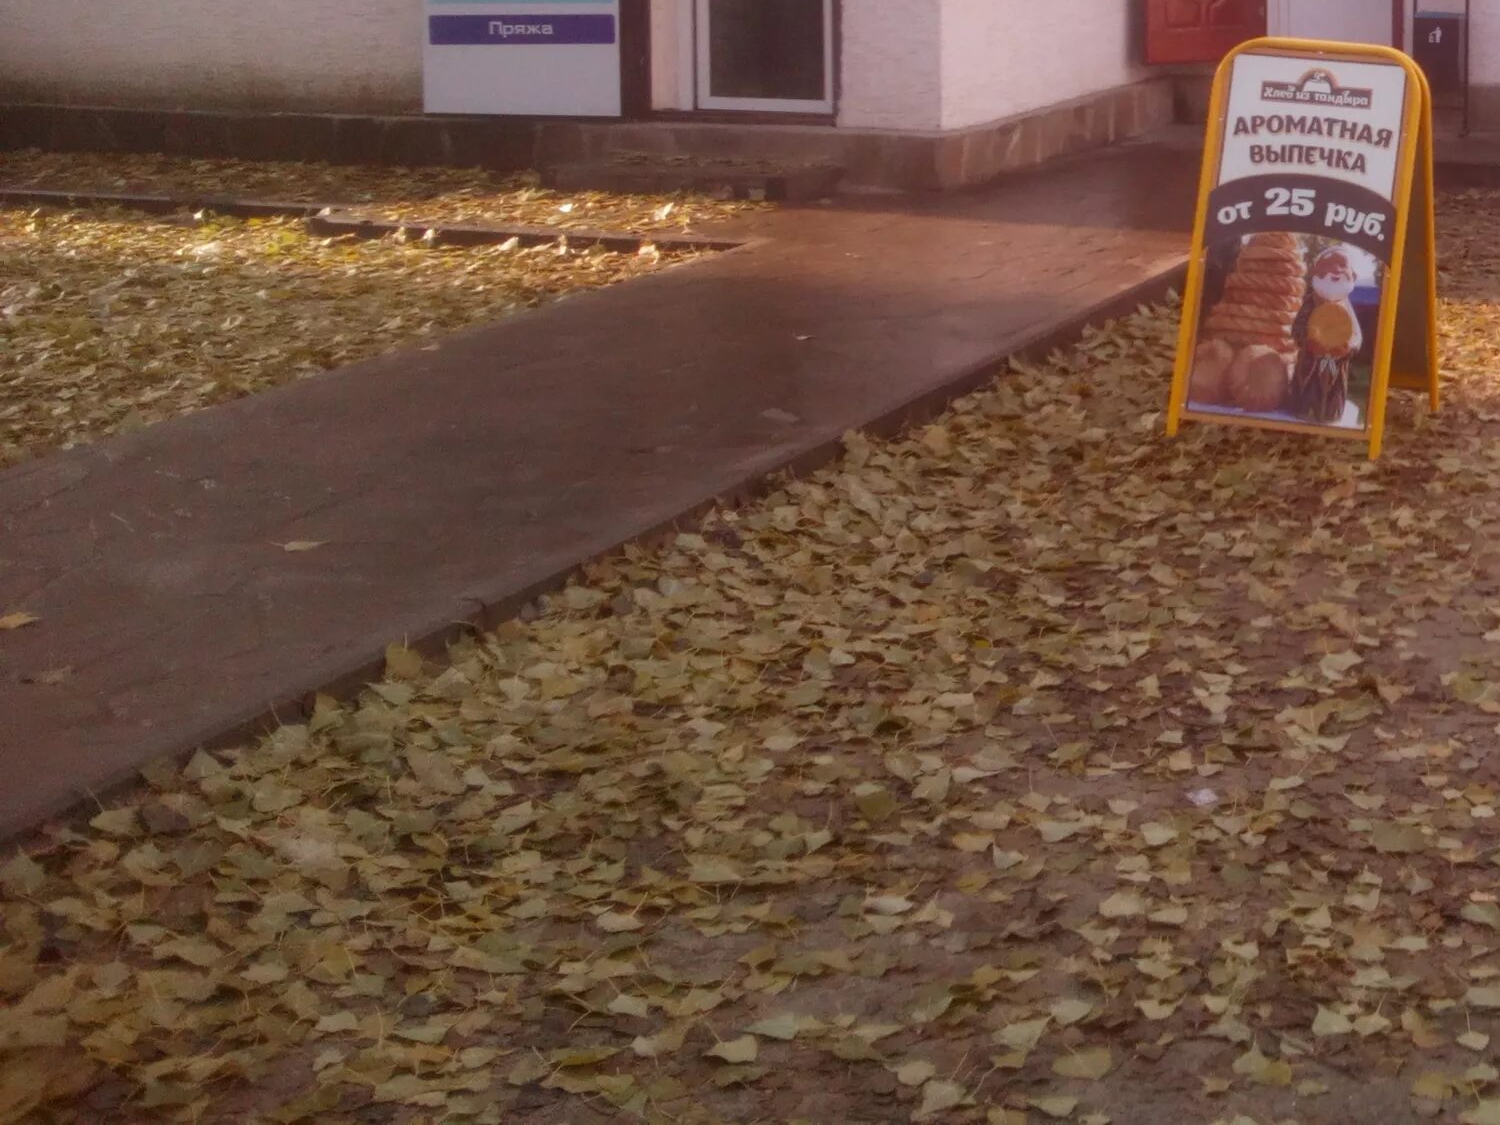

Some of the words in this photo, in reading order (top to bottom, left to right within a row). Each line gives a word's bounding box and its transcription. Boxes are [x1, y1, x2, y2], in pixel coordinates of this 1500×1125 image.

[488, 21, 553, 38] Пряжа
[1263, 84, 1296, 98] Хлеб
[1296, 91, 1310, 100] из
[1314, 90, 1369, 106] тандыра
[1233, 114, 1394, 149] АРОМАТНАЯ
[1249, 144, 1367, 173] ВЫПЕЧКА
[1217, 200, 1254, 224] от
[1264, 188, 1317, 216] 25
[1324, 200, 1386, 241] руб.
